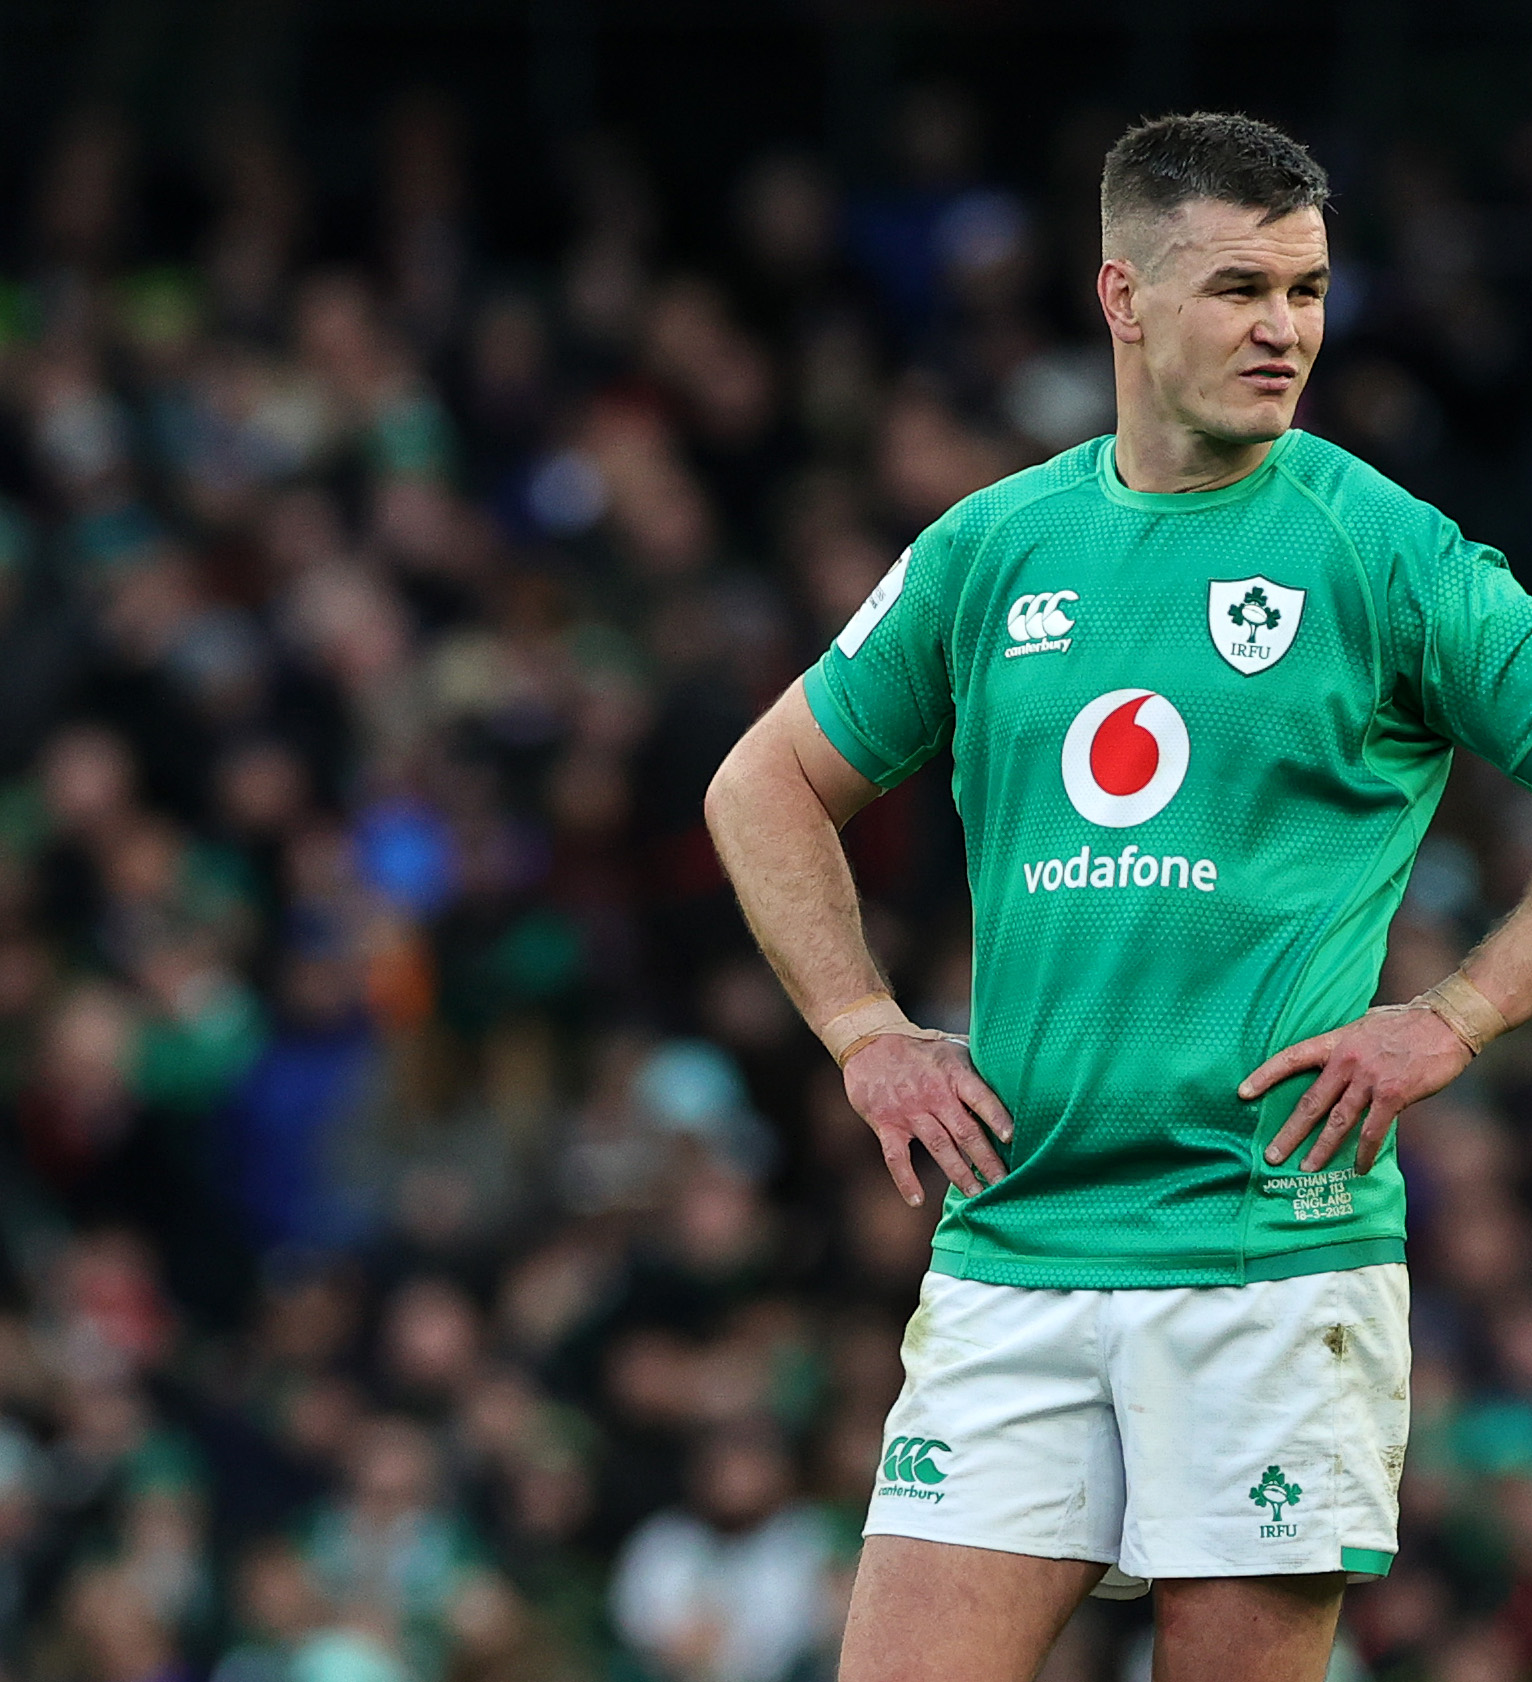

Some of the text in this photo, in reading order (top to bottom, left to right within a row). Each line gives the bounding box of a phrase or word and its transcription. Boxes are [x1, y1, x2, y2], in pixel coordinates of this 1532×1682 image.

[1004, 637, 1073, 658] canterbury
[1230, 642, 1271, 660] IRFU
[1023, 844, 1218, 894] vodafone
[1263, 1173, 1328, 1190] JONATHAN
[1296, 1182, 1345, 1198] CAP 113
[1293, 1192, 1351, 1210] ENGLAND
[1294, 1204, 1353, 1220] 18-3-2023
[878, 1484, 945, 1504] canterbury
[1259, 1524, 1297, 1538] IRFU
